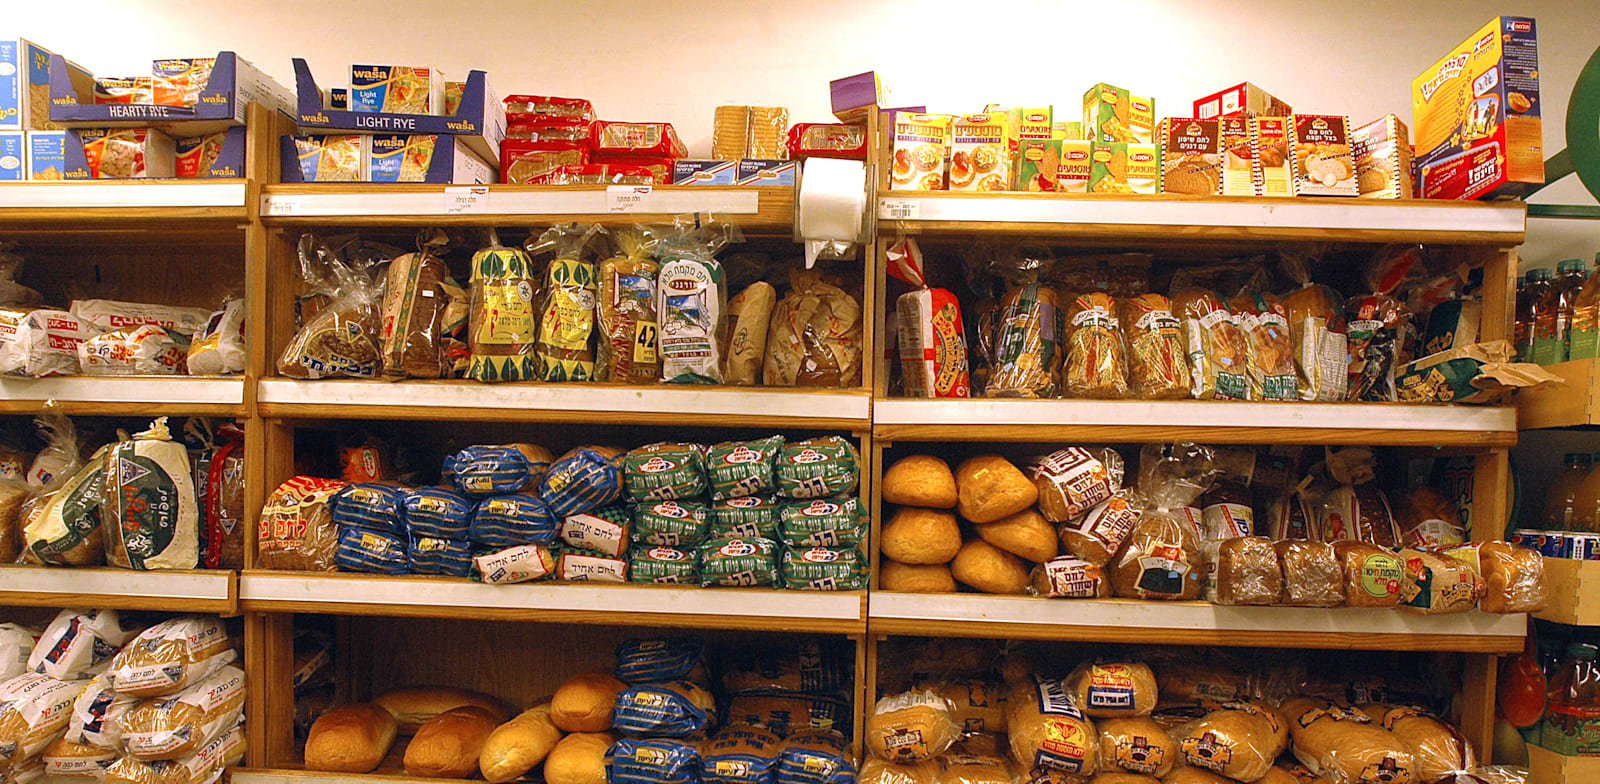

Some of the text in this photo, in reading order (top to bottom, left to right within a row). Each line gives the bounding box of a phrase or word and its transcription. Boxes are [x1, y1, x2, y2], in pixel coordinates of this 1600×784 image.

[353, 68, 388, 80] wasa
[52, 96, 76, 105] wasa
[202, 94, 227, 104] wasa
[360, 90, 377, 100] Light
[109, 105, 170, 118] HEARTY RYE
[301, 113, 330, 124] wasa
[356, 116, 416, 130] LIGHT RYE
[446, 120, 475, 131] wasa
[374, 138, 404, 148] wasa
[378, 158, 394, 168] Light
[66, 168, 88, 178] wasa
[211, 168, 236, 176] wasa
[674, 265, 696, 276] מקמח
[662, 270, 674, 286] מלא
[638, 325, 656, 348] 42
[1072, 476, 1093, 492] לחם
[1081, 481, 1105, 499] שחור
[274, 512, 308, 538] לחם
[1102, 510, 1116, 529] לחם
[1112, 510, 1132, 531] שחור
[570, 519, 613, 540] לחם אחיד
[486, 548, 529, 570] לחם אחיד
[572, 564, 616, 574] לחם אחיד
[1064, 570, 1085, 582] לחם
[1374, 576, 1387, 585] מלא
[1069, 580, 1092, 590] שחור
[216, 684, 228, 694] כהה
[54, 700, 70, 712] כהה
